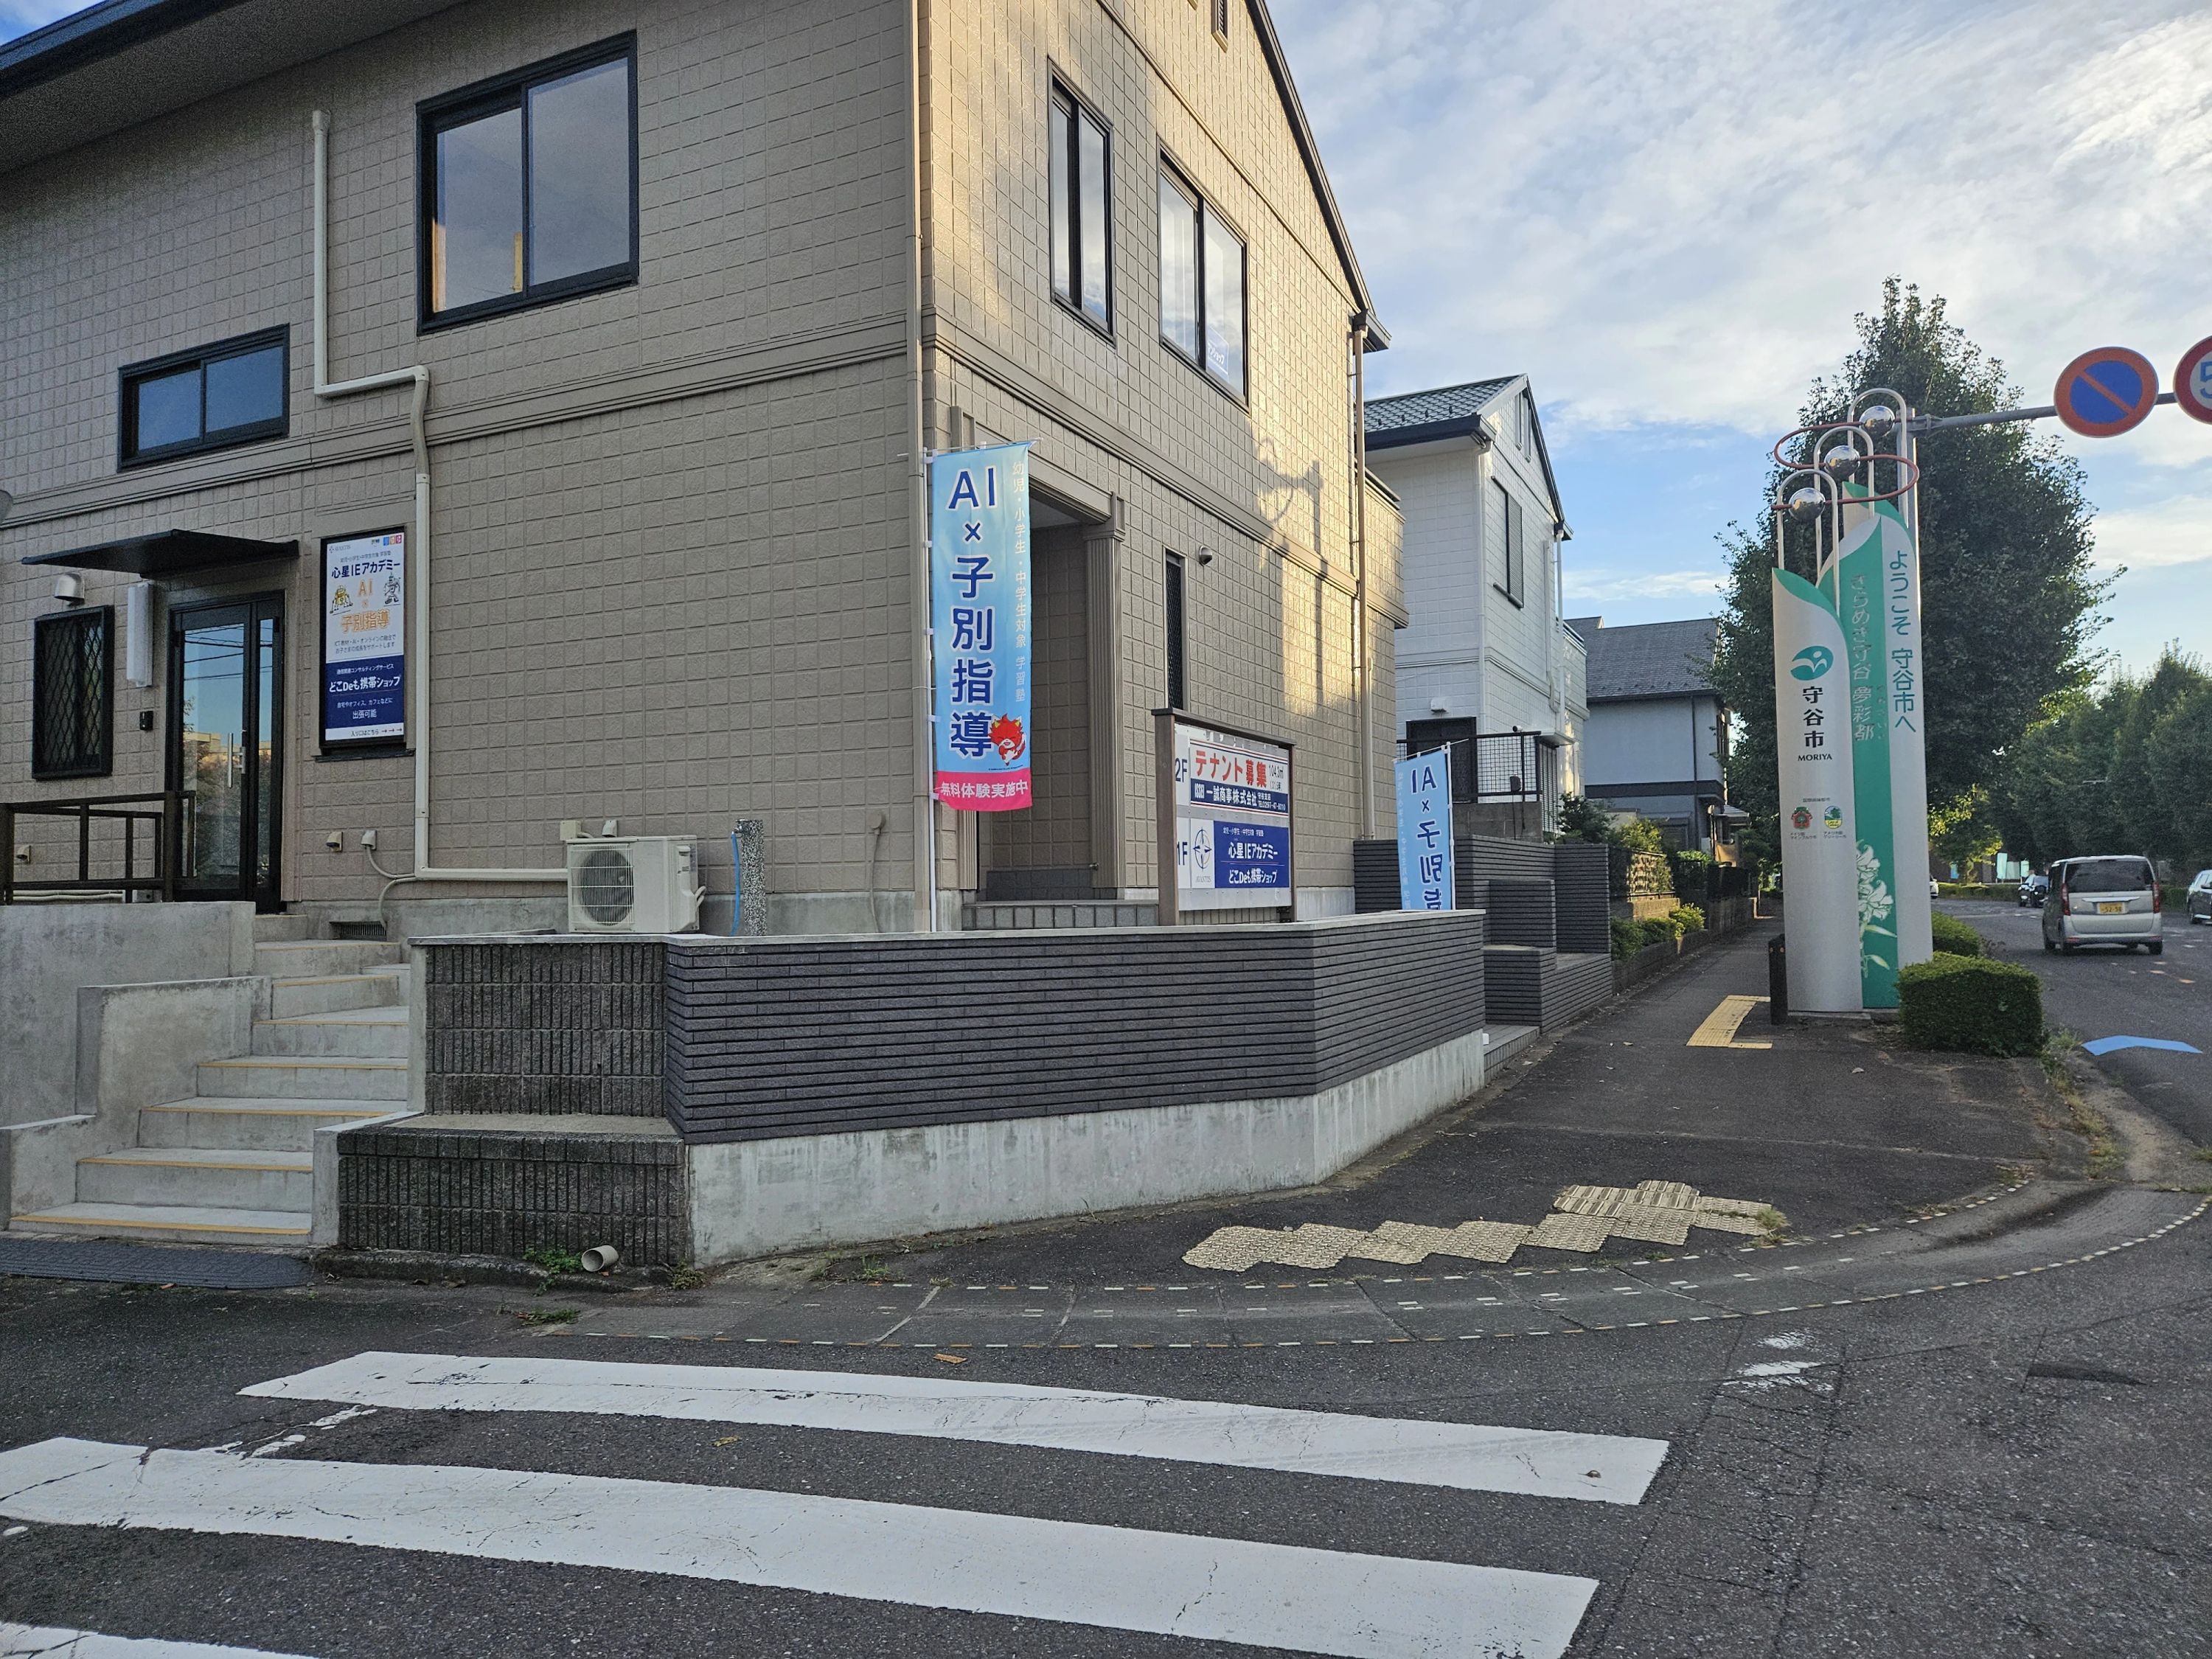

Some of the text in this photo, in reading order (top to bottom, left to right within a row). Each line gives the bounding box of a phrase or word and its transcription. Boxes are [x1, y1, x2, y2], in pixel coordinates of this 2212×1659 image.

[331, 560, 400, 579] 心星IEアカデミー
[358, 579, 373, 597] AI
[341, 608, 390, 634] 子別指導
[1890, 550, 1916, 733] ようこそ 守谷市へ
[329, 675, 401, 692] どこDeも携帯ショップ
[352, 709, 378, 720] 出張可能
[1802, 686, 1824, 748] 守谷市
[1798, 754, 1832, 762] MORIYA
[1175, 757, 1188, 783] 2F
[1195, 750, 1267, 788] テナント募集
[941, 779, 1028, 799] 無料体験実施中
[1206, 785, 1257, 807] 一誠商事株式会社
[1176, 841, 1188, 866] 1F
[1228, 842, 1279, 860] 心星IEアカデミー
[1228, 868, 1278, 884] どこDeも携帯ショップ
